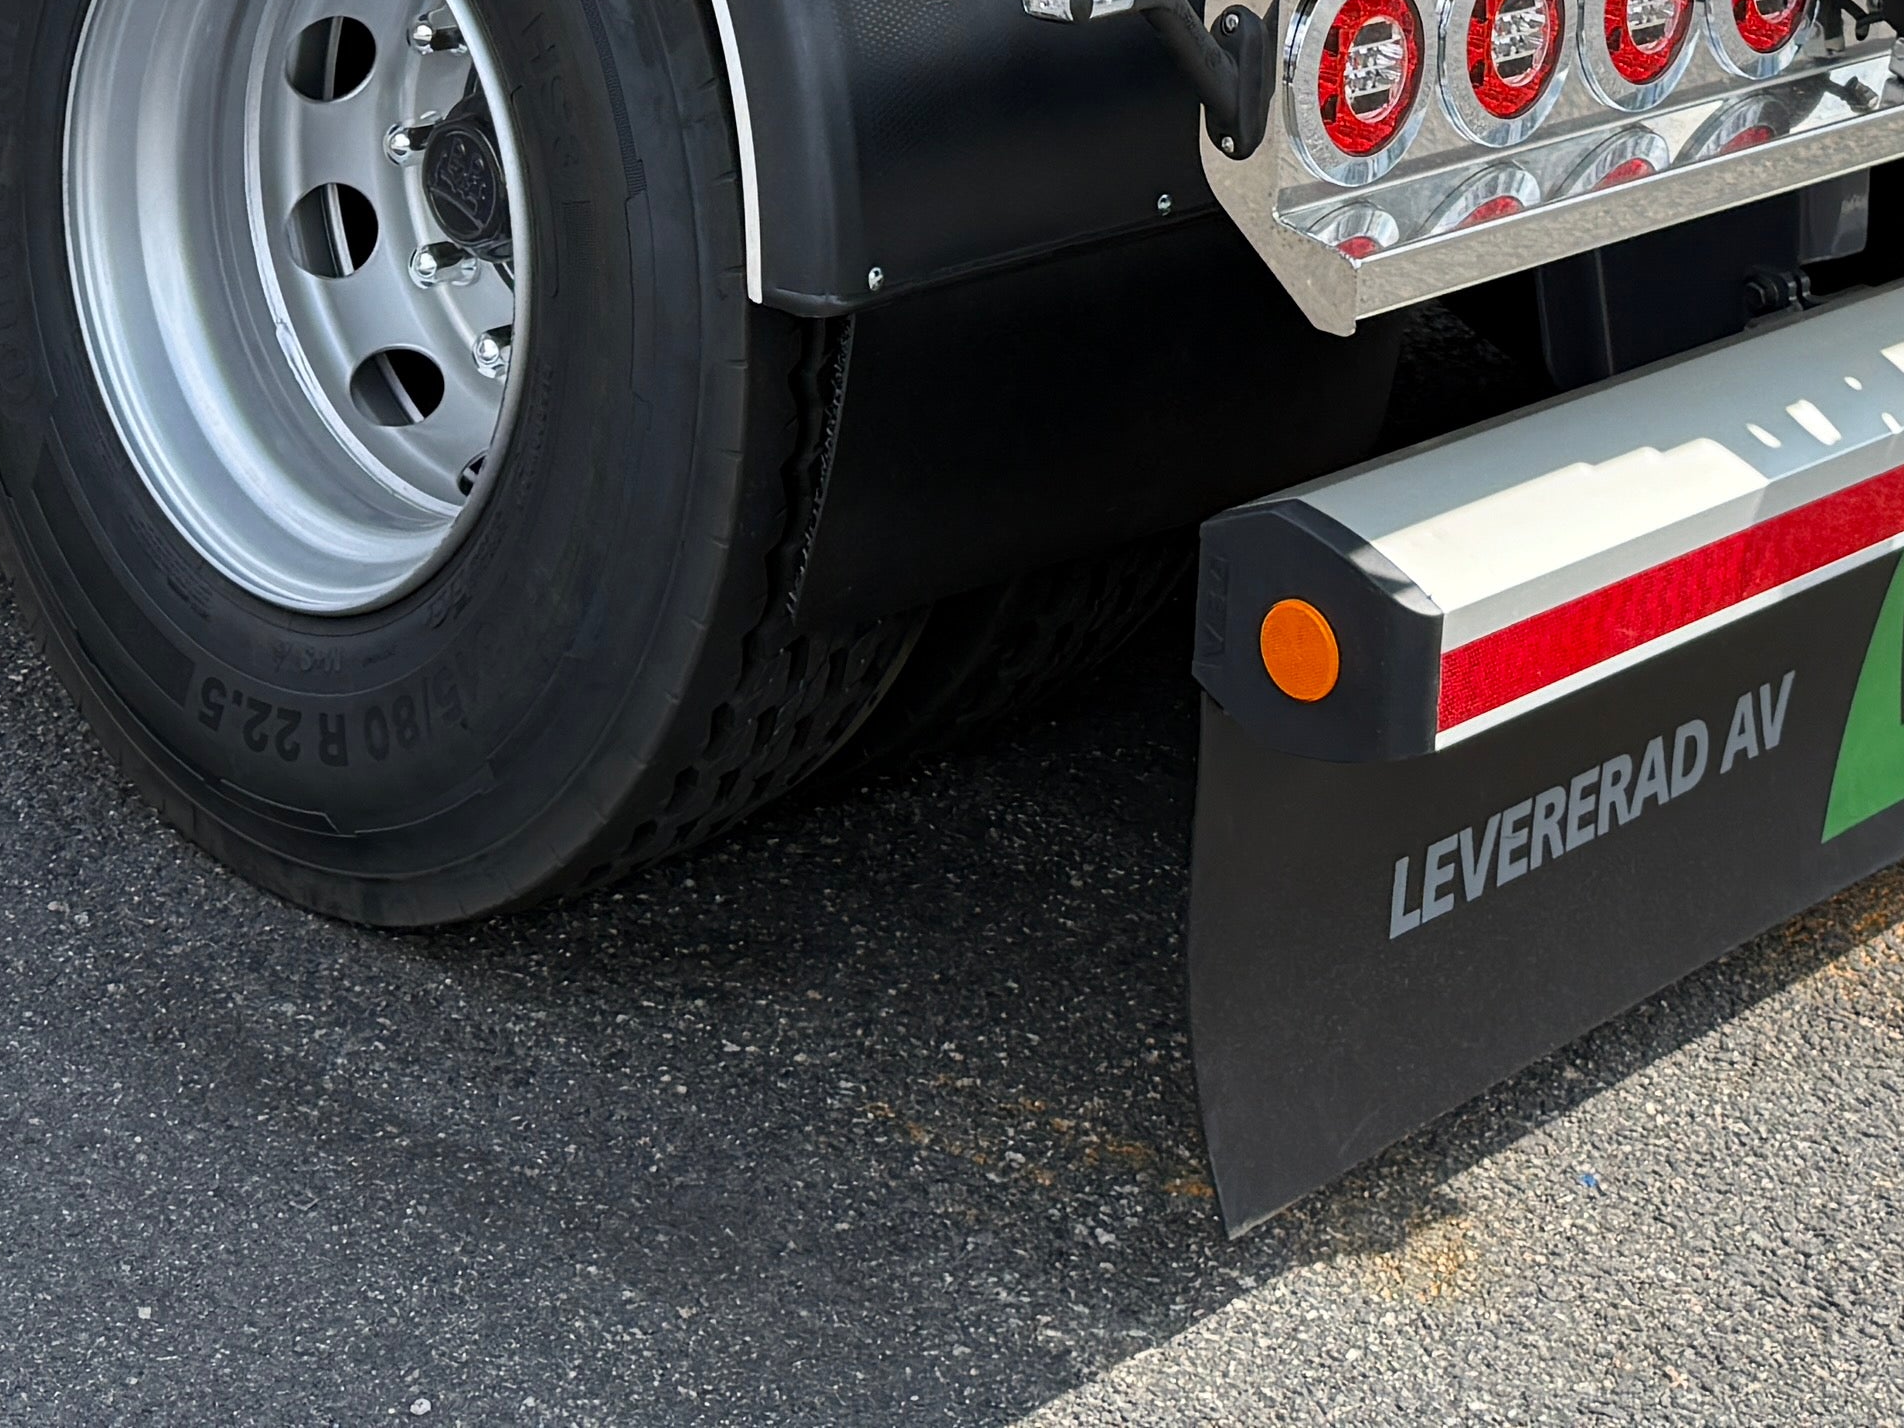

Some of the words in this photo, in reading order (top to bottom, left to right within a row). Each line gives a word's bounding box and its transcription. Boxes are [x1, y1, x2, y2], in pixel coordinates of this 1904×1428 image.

[199, 676, 303, 763] 22.5
[317, 712, 347, 767] R
[1389, 718, 1710, 940] LEVERERAD
[1719, 669, 1796, 776] AV
